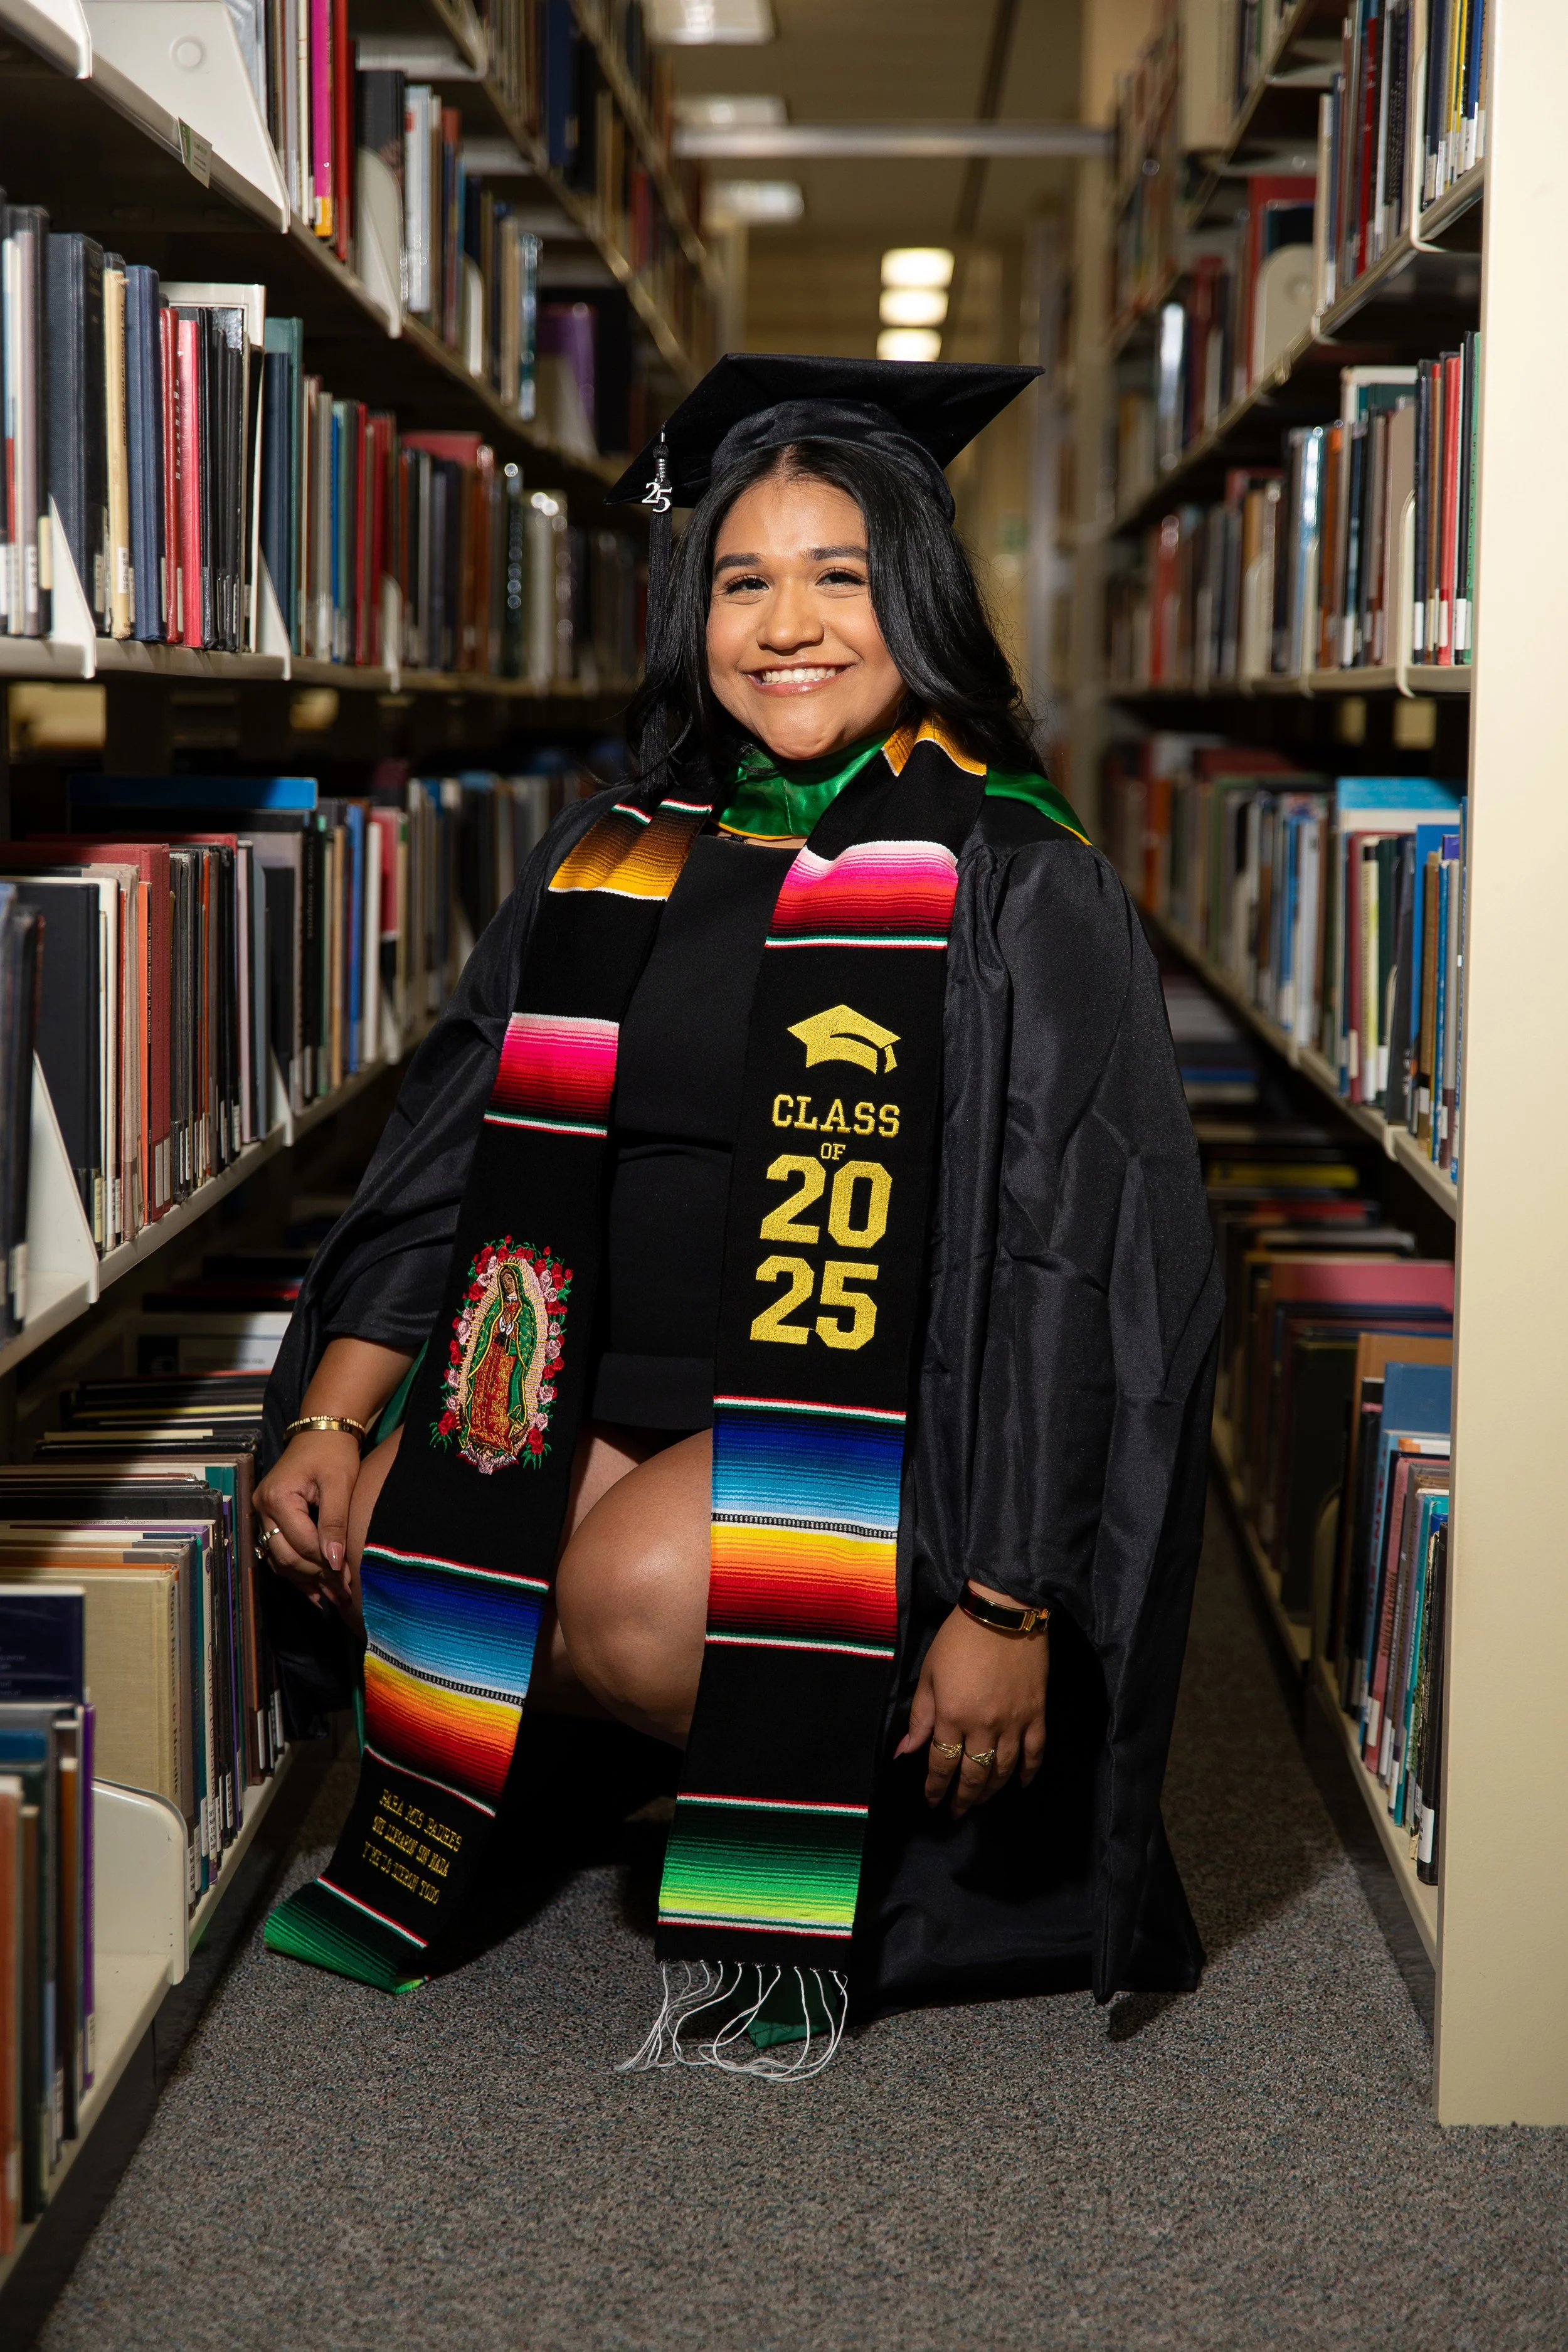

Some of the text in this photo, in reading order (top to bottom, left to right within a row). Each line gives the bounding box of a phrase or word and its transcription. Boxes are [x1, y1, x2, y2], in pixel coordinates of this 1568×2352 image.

[642, 482, 672, 512] 25
[772, 1094, 900, 1138] CLASS
[820, 1143, 846, 1160] OF
[760, 1154, 893, 1248] 20
[750, 1255, 879, 1350] 25
[379, 1788, 462, 1852] PARA MIS PADRES
[415, 1845, 431, 1865] SIN
[428, 1852, 450, 1877] NADA
[419, 1880, 440, 1905] TODO
